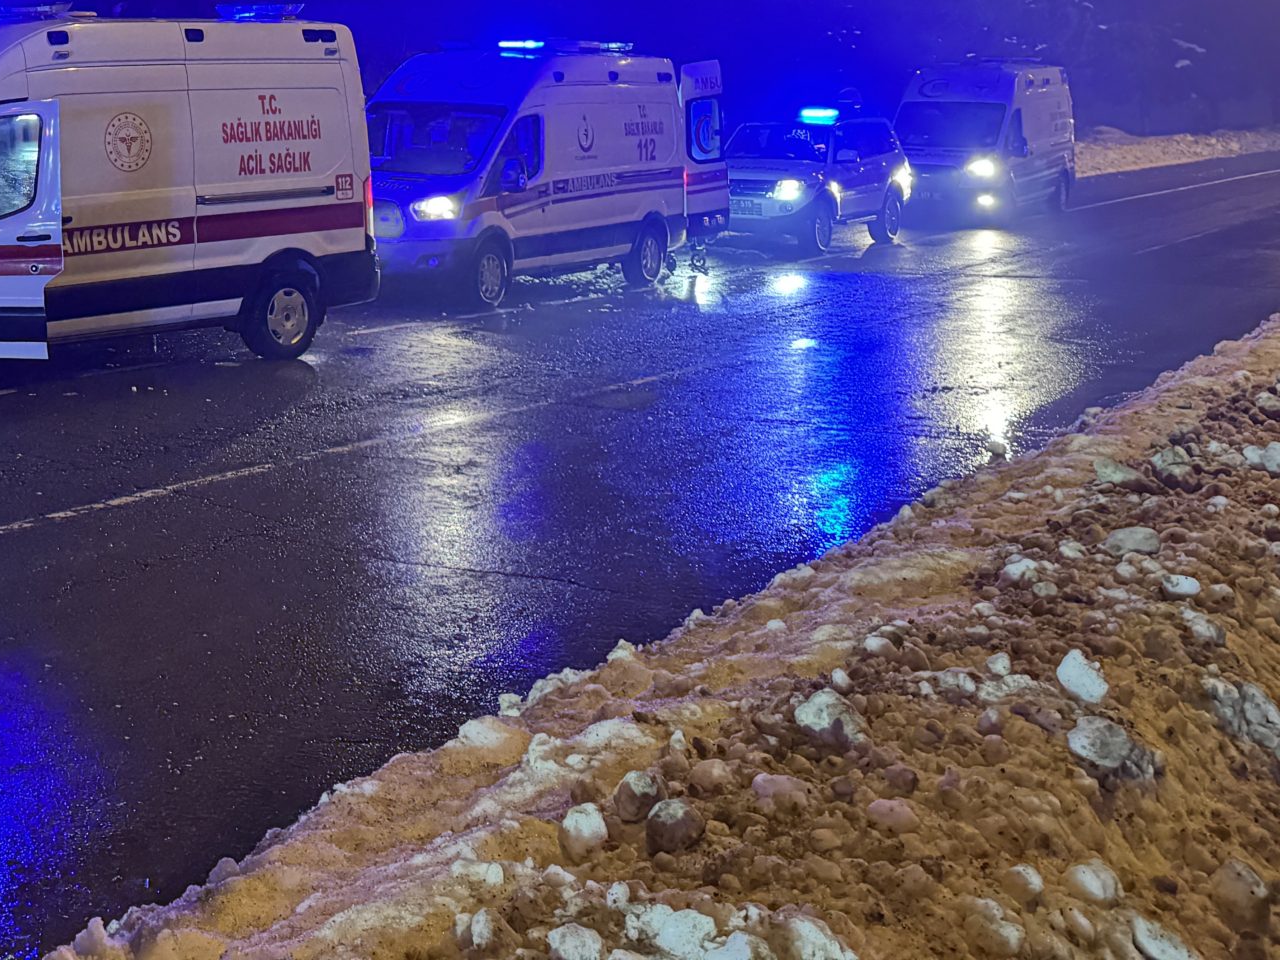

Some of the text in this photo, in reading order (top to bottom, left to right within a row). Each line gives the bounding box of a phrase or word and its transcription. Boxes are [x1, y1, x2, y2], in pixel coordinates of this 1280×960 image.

[258, 95, 281, 115] T.C.
[222, 115, 321, 144] SAĞLIK BAKANLIĞI
[239, 148, 312, 176] ACİL SAĞLIK
[637, 138, 656, 162] 112
[338, 176, 352, 190] 112
[568, 172, 617, 192] AMBULANS
[62, 221, 181, 253] AMBULANS
